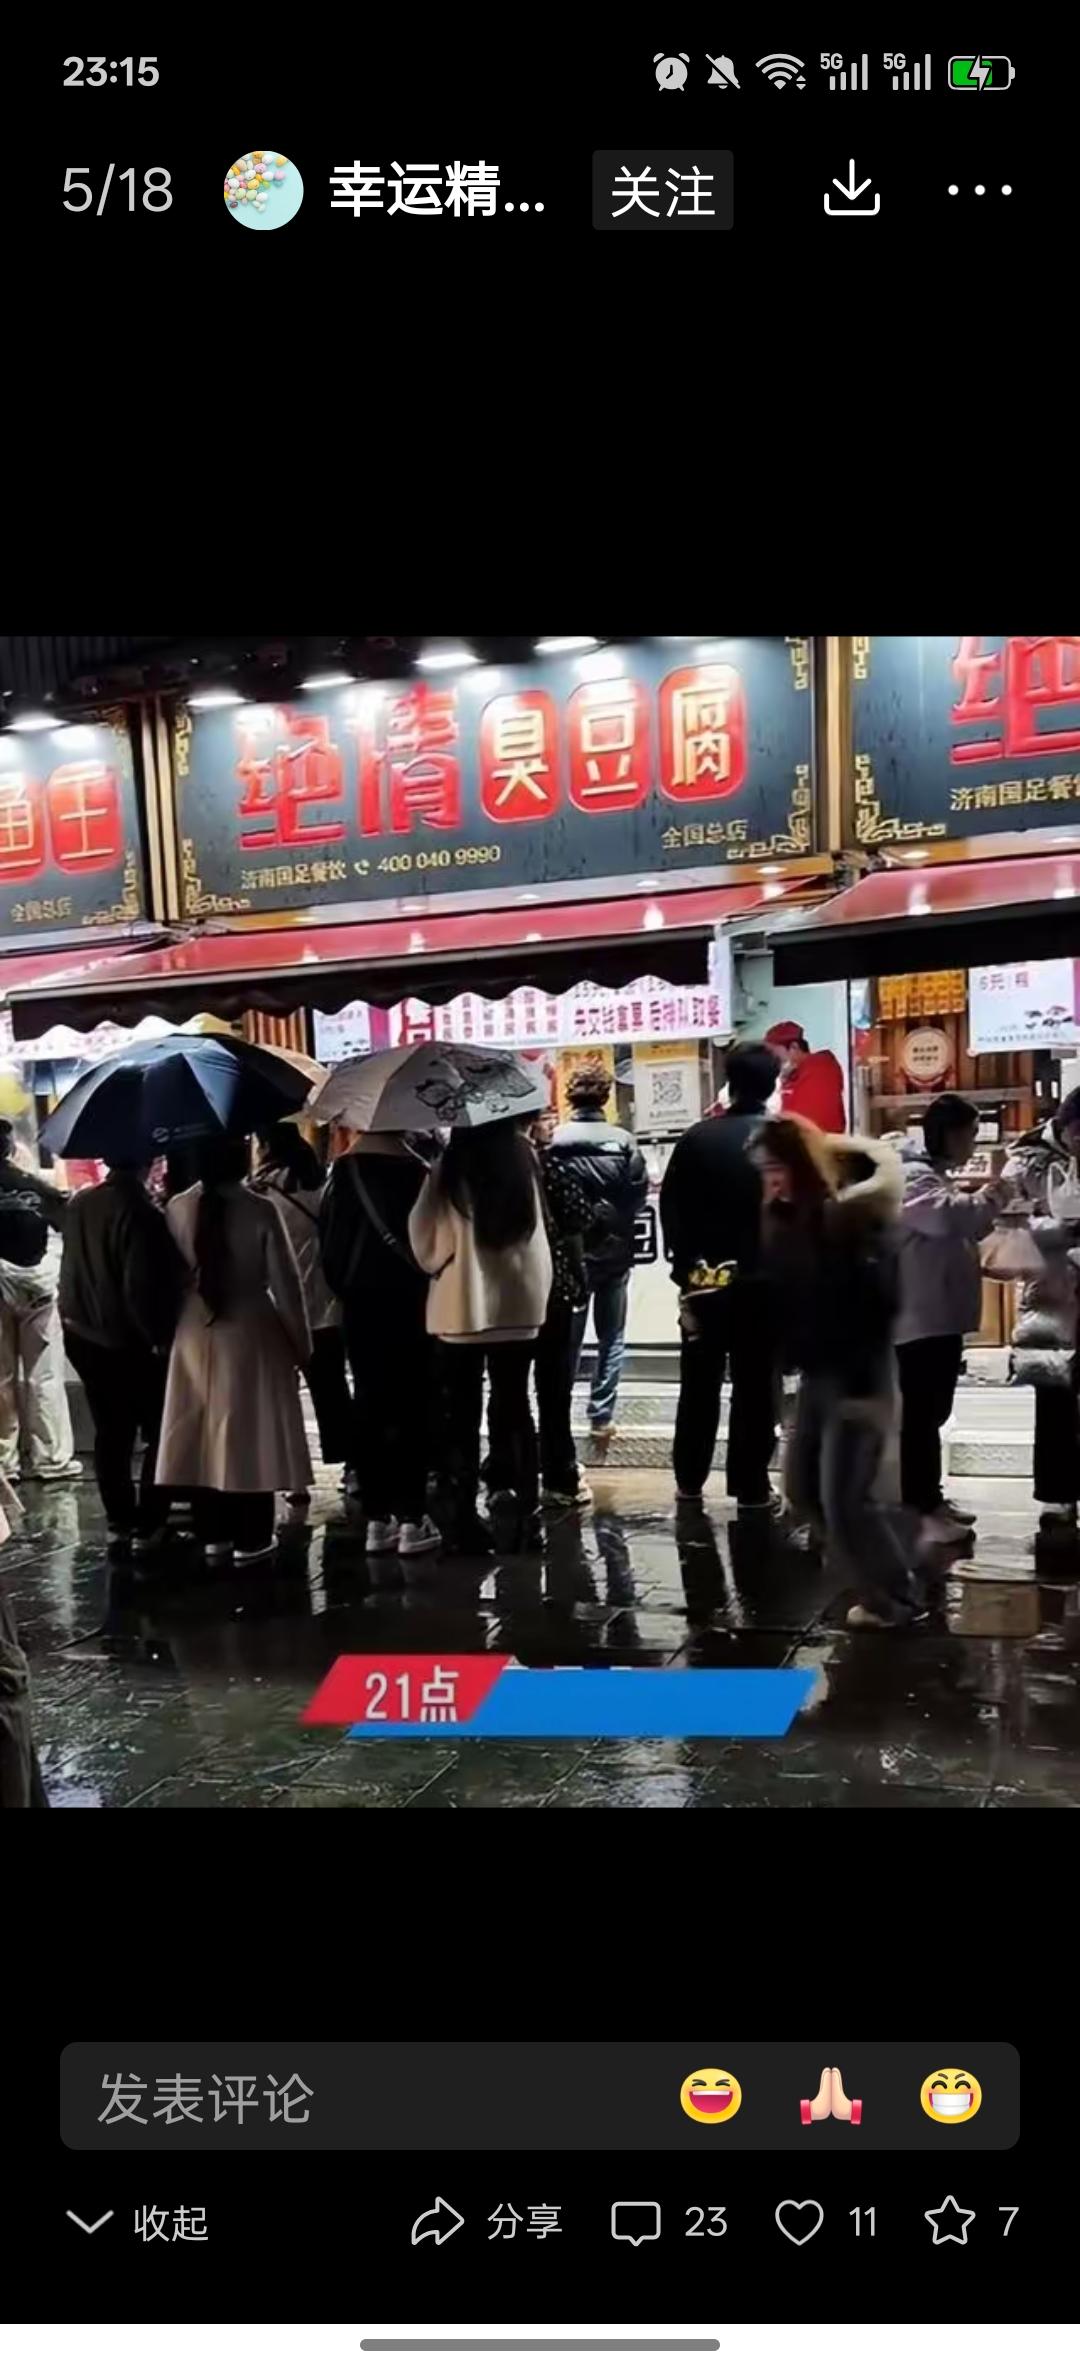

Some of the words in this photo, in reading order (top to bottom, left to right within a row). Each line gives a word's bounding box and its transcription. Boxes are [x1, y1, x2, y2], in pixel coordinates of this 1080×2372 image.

[238, 680, 734, 850] 绝情臭豆腐
[661, 819, 748, 849] 全国总店
[241, 860, 347, 890] 济南国足餐饮
[377, 853, 411, 873] 400
[416, 851, 451, 867] 040
[455, 845, 501, 866] 9990
